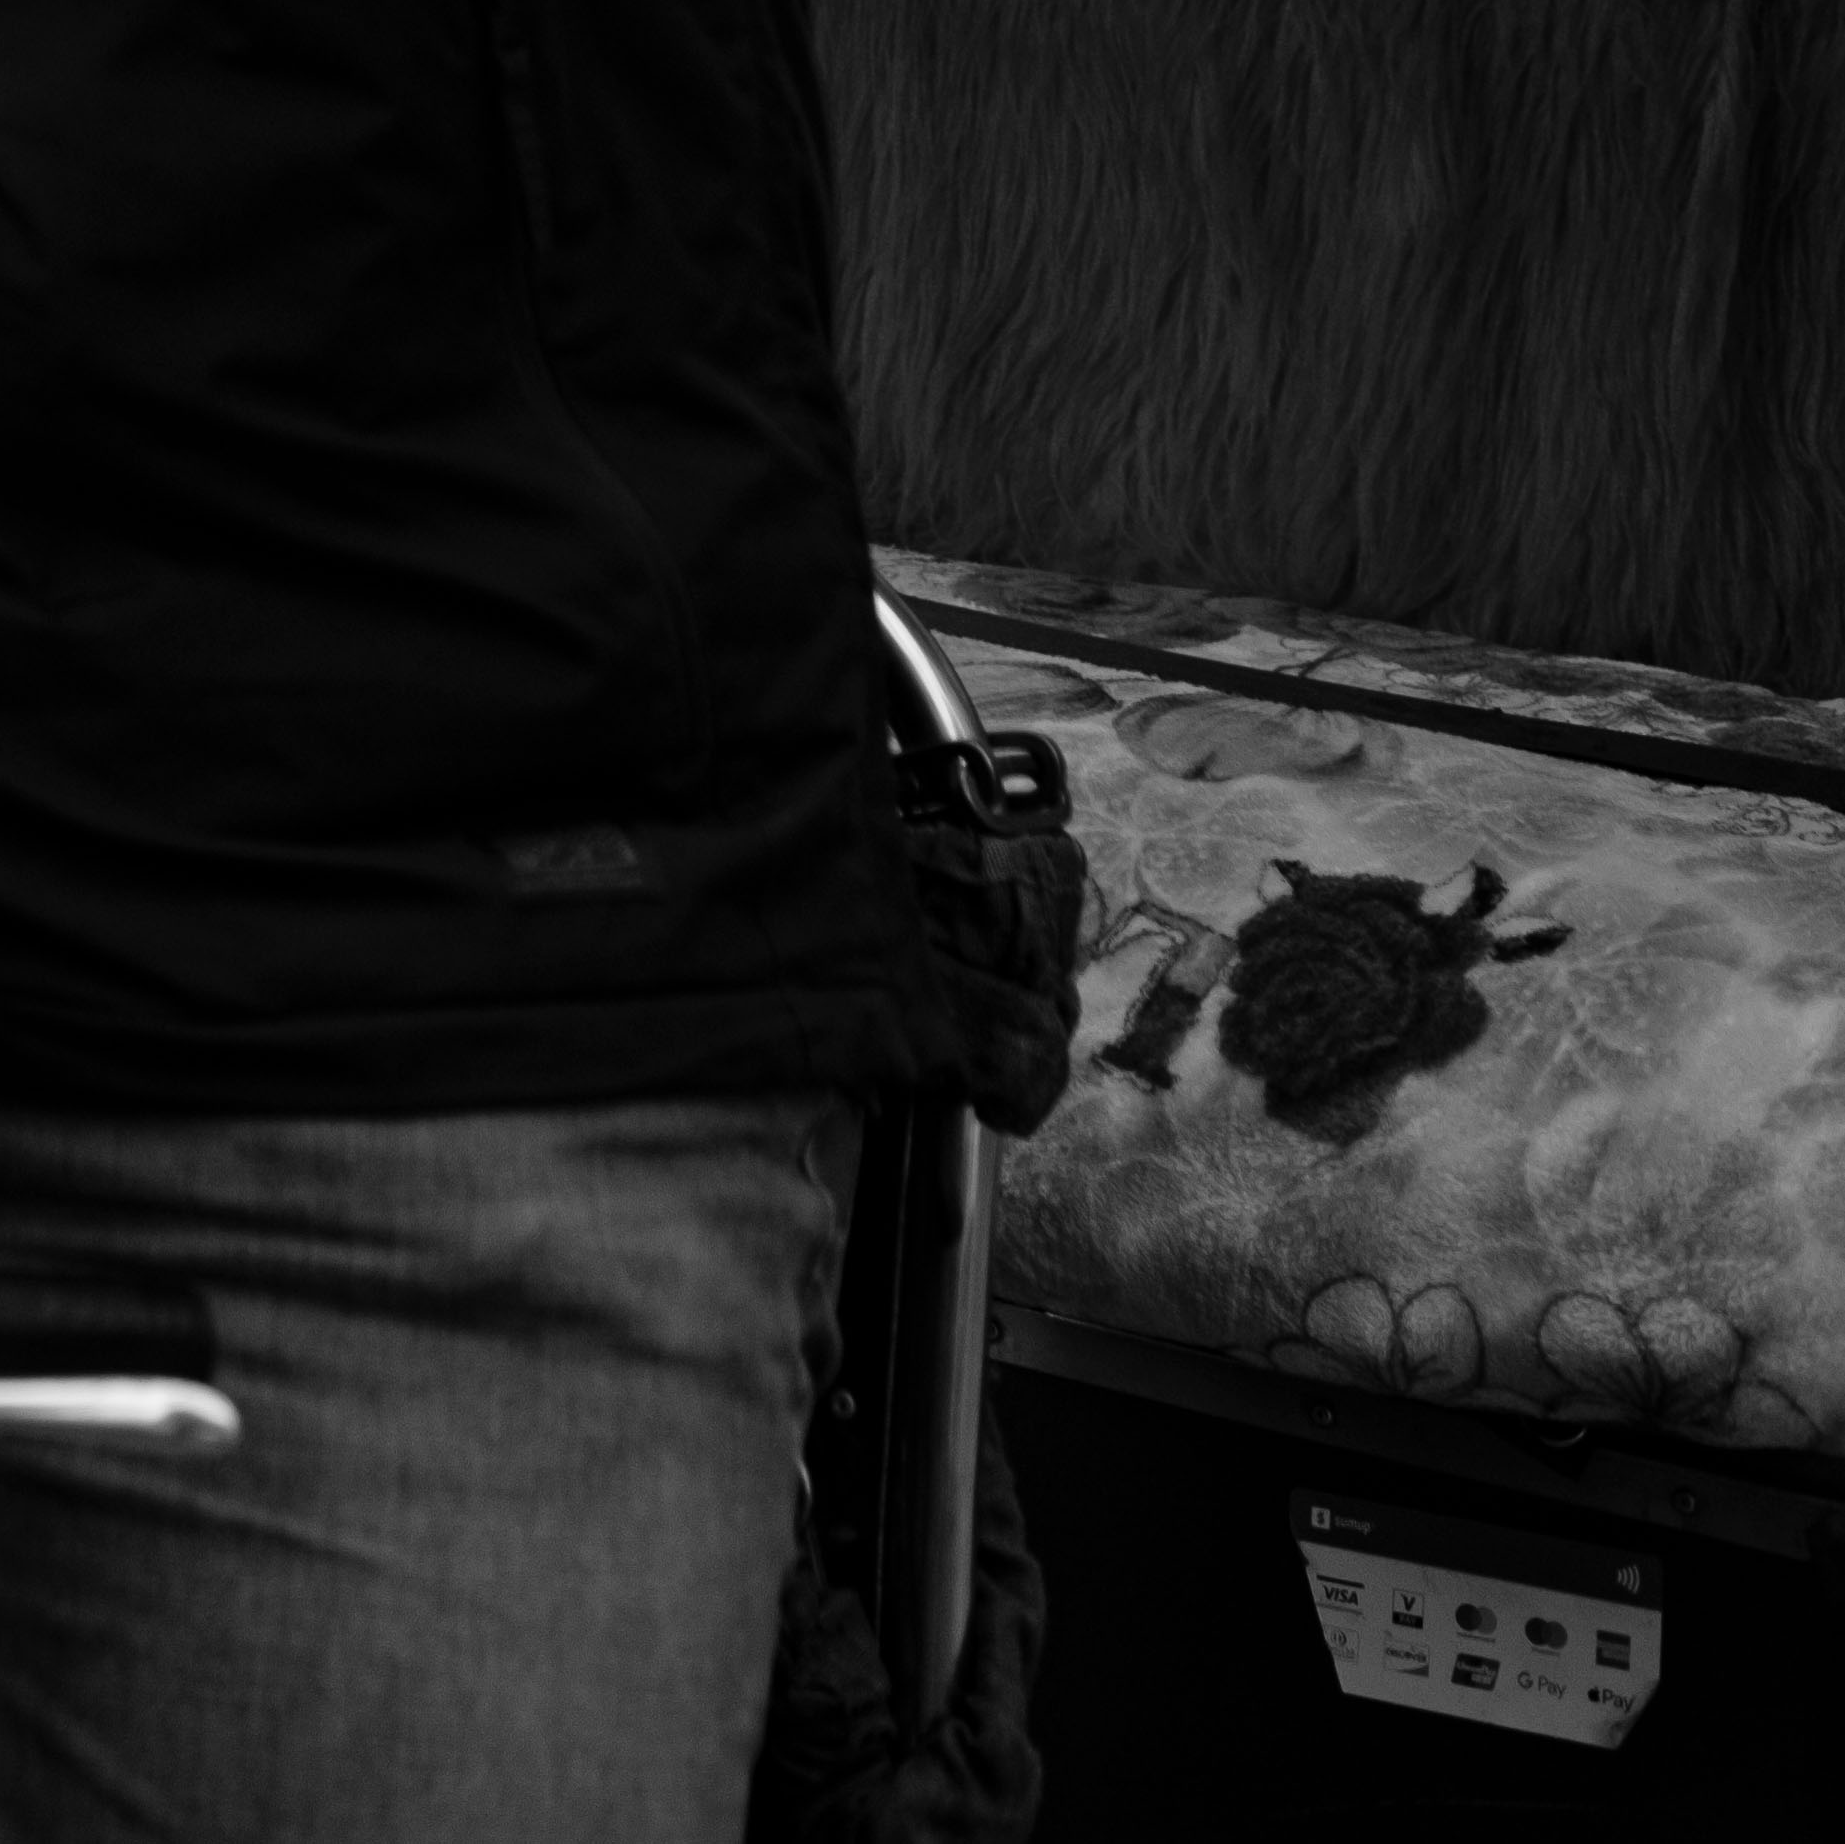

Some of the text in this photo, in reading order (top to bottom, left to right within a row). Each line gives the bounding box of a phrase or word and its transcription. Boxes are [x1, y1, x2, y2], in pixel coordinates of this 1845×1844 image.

[1323, 1585, 1359, 1606] VISA
[1517, 1670, 1534, 1690] G
[1538, 1674, 1567, 1700] Pay
[1602, 1688, 1635, 1713] Pay
